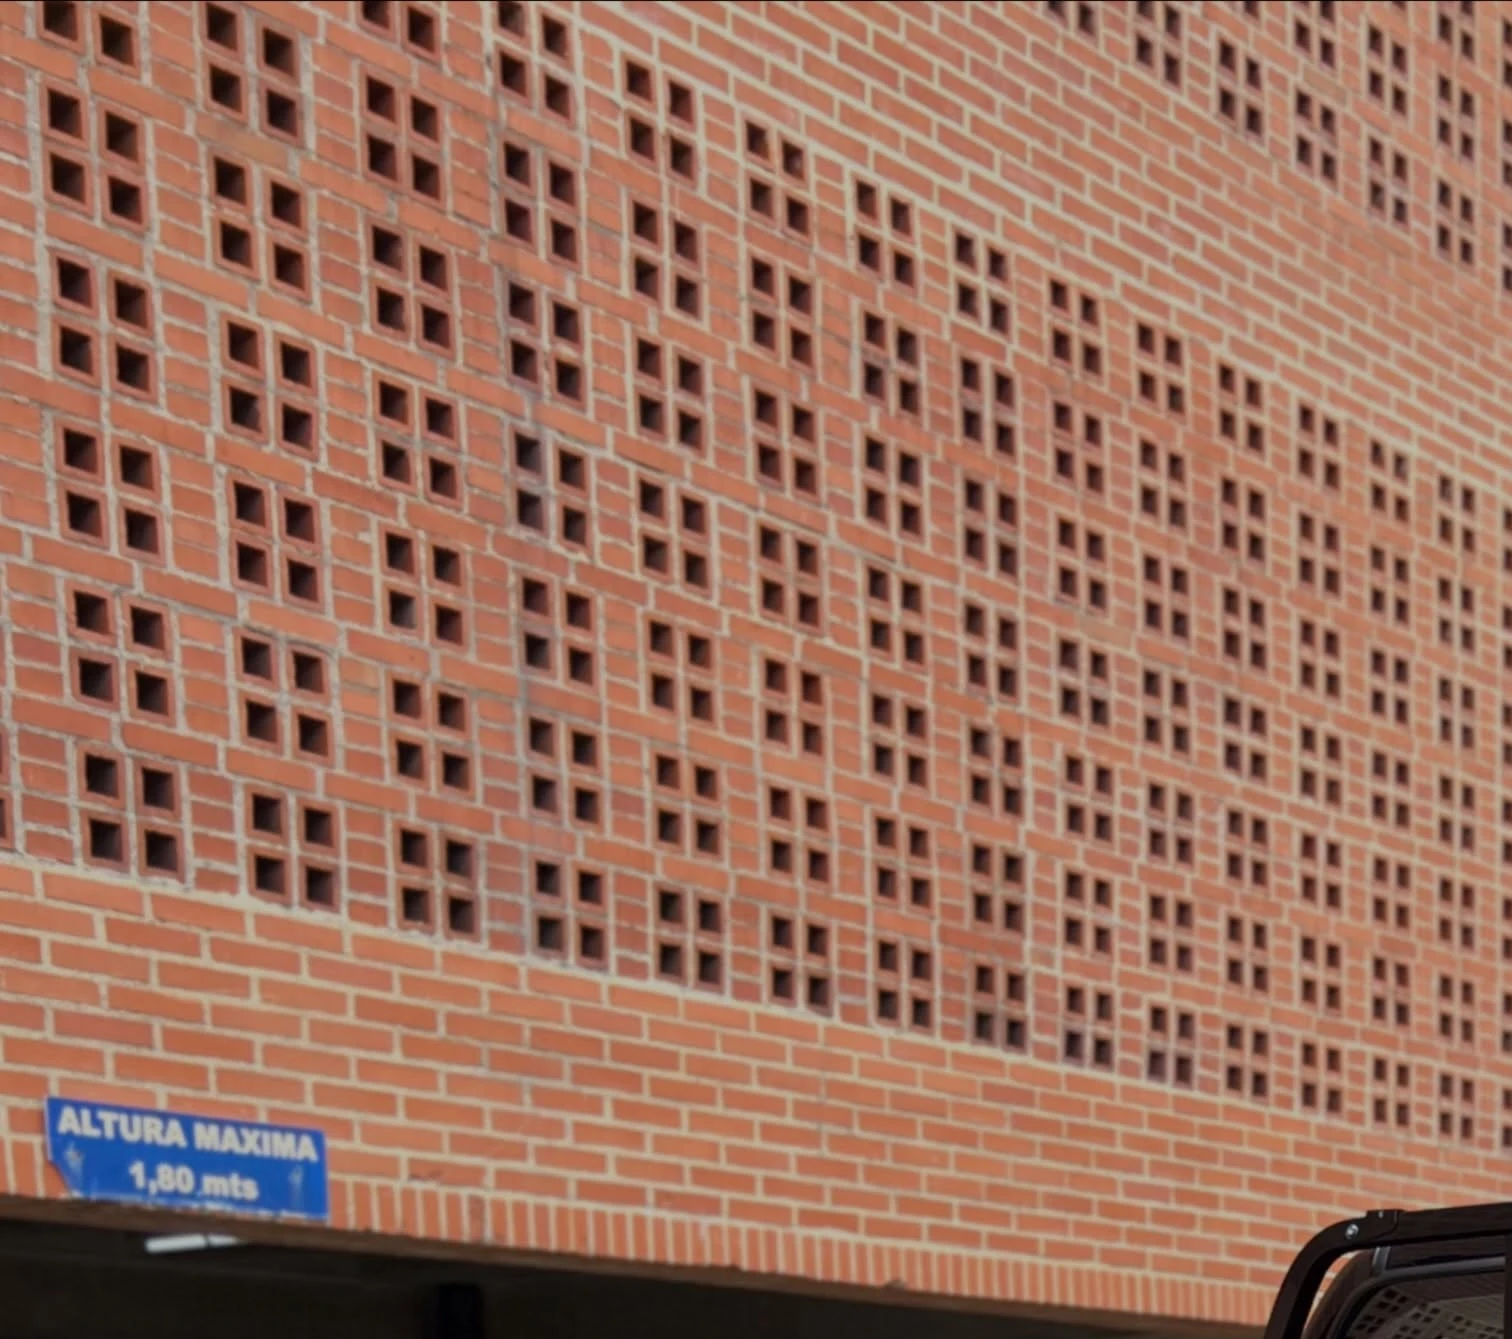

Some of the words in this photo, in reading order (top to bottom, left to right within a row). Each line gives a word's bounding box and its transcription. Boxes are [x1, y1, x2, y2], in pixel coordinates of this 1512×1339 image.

[58, 1106, 187, 1148] ALTURA
[194, 1121, 319, 1163] MAXIMA
[129, 1160, 193, 1197] 1,80
[202, 1171, 259, 1201] mts
